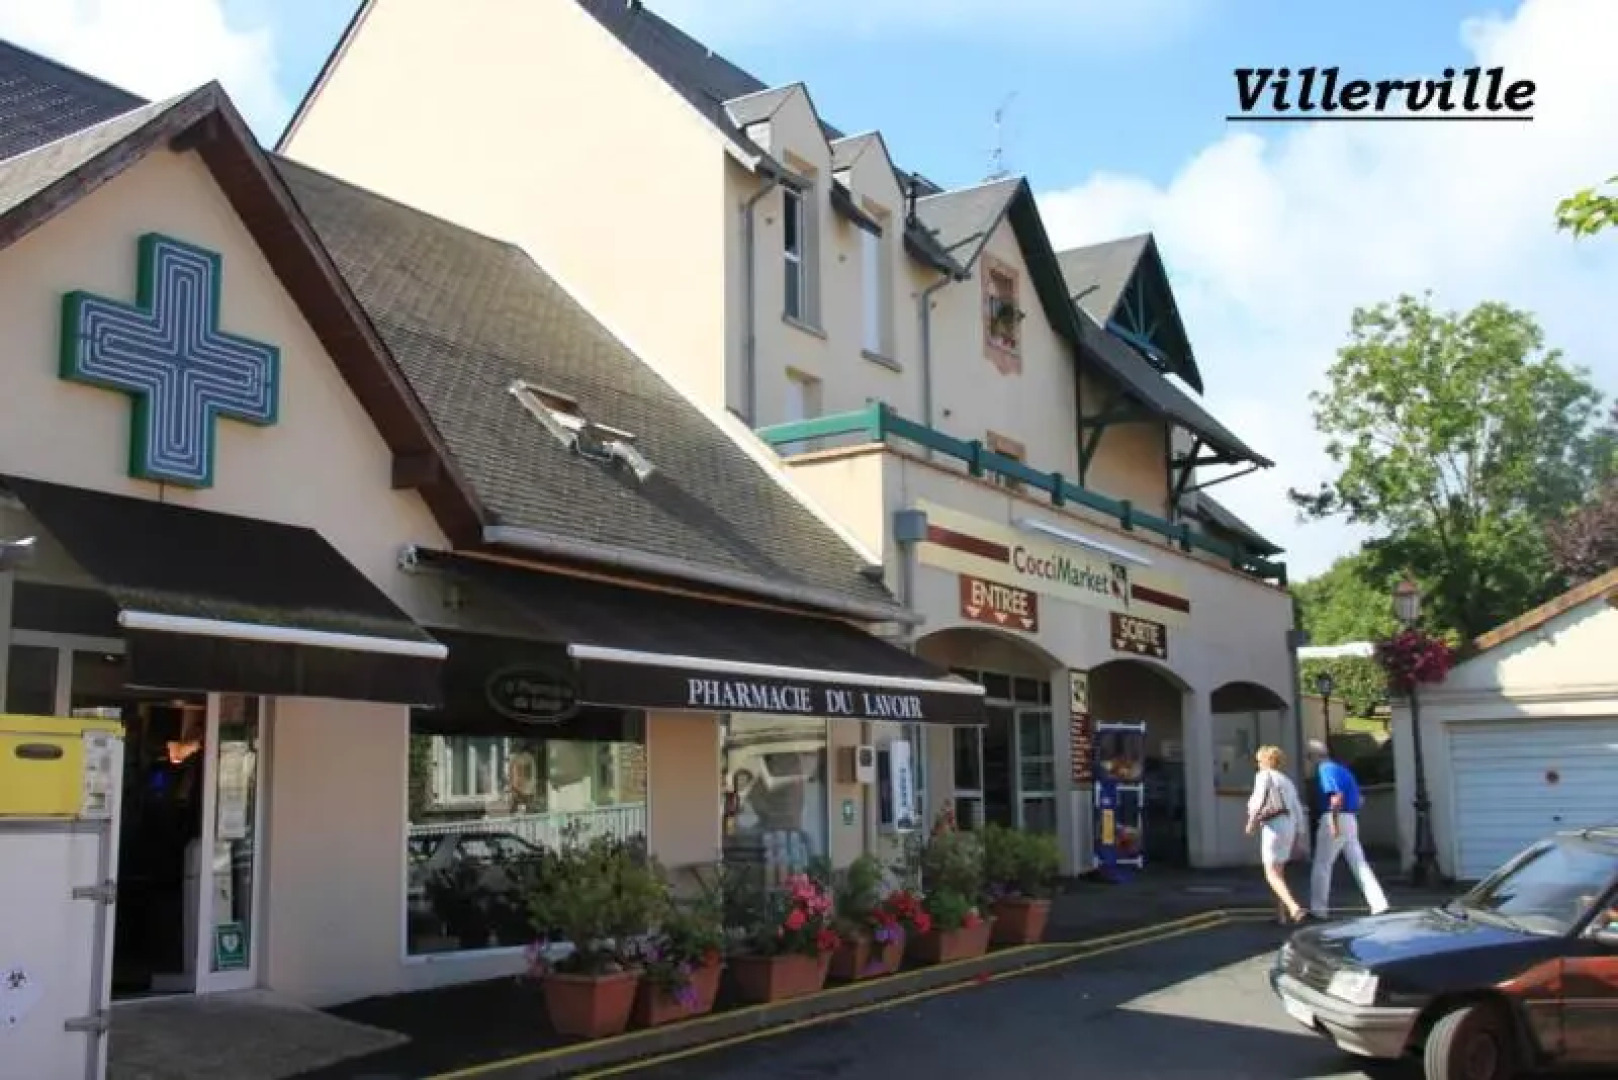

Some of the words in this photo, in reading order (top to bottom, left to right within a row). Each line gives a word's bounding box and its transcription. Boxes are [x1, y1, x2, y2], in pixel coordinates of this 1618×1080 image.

[1012, 546, 1109, 593] CocciMarket
[688, 679, 813, 712] PHARMACIE
[825, 689, 853, 714] DU
[863, 693, 923, 718] LAVOIR
